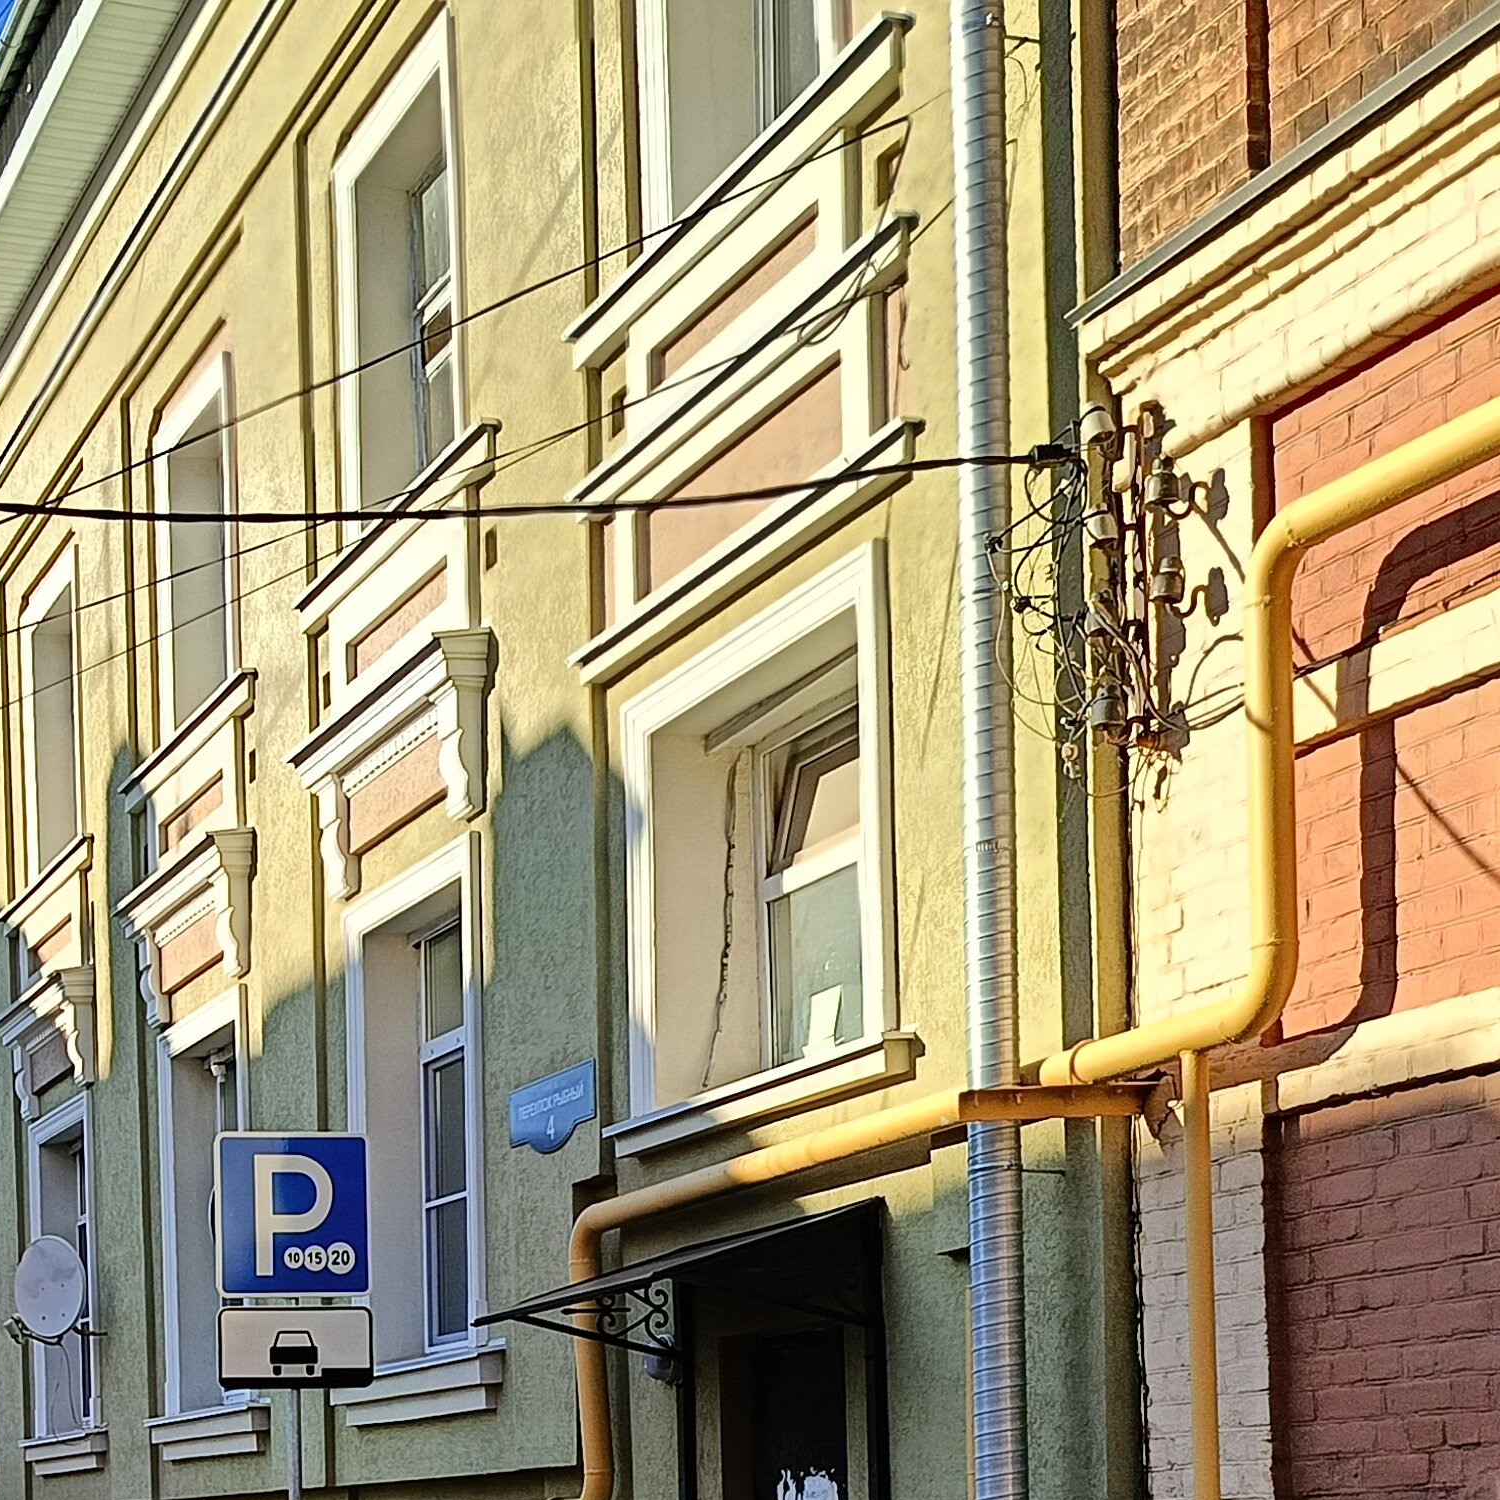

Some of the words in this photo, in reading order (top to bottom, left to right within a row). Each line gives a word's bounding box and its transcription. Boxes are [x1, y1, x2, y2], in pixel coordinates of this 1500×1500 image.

[546, 1115, 555, 1140] 4
[253, 1154, 334, 1277] P
[287, 1252, 300, 1264] 10
[307, 1251, 323, 1265] 15
[331, 1249, 351, 1266] 20
